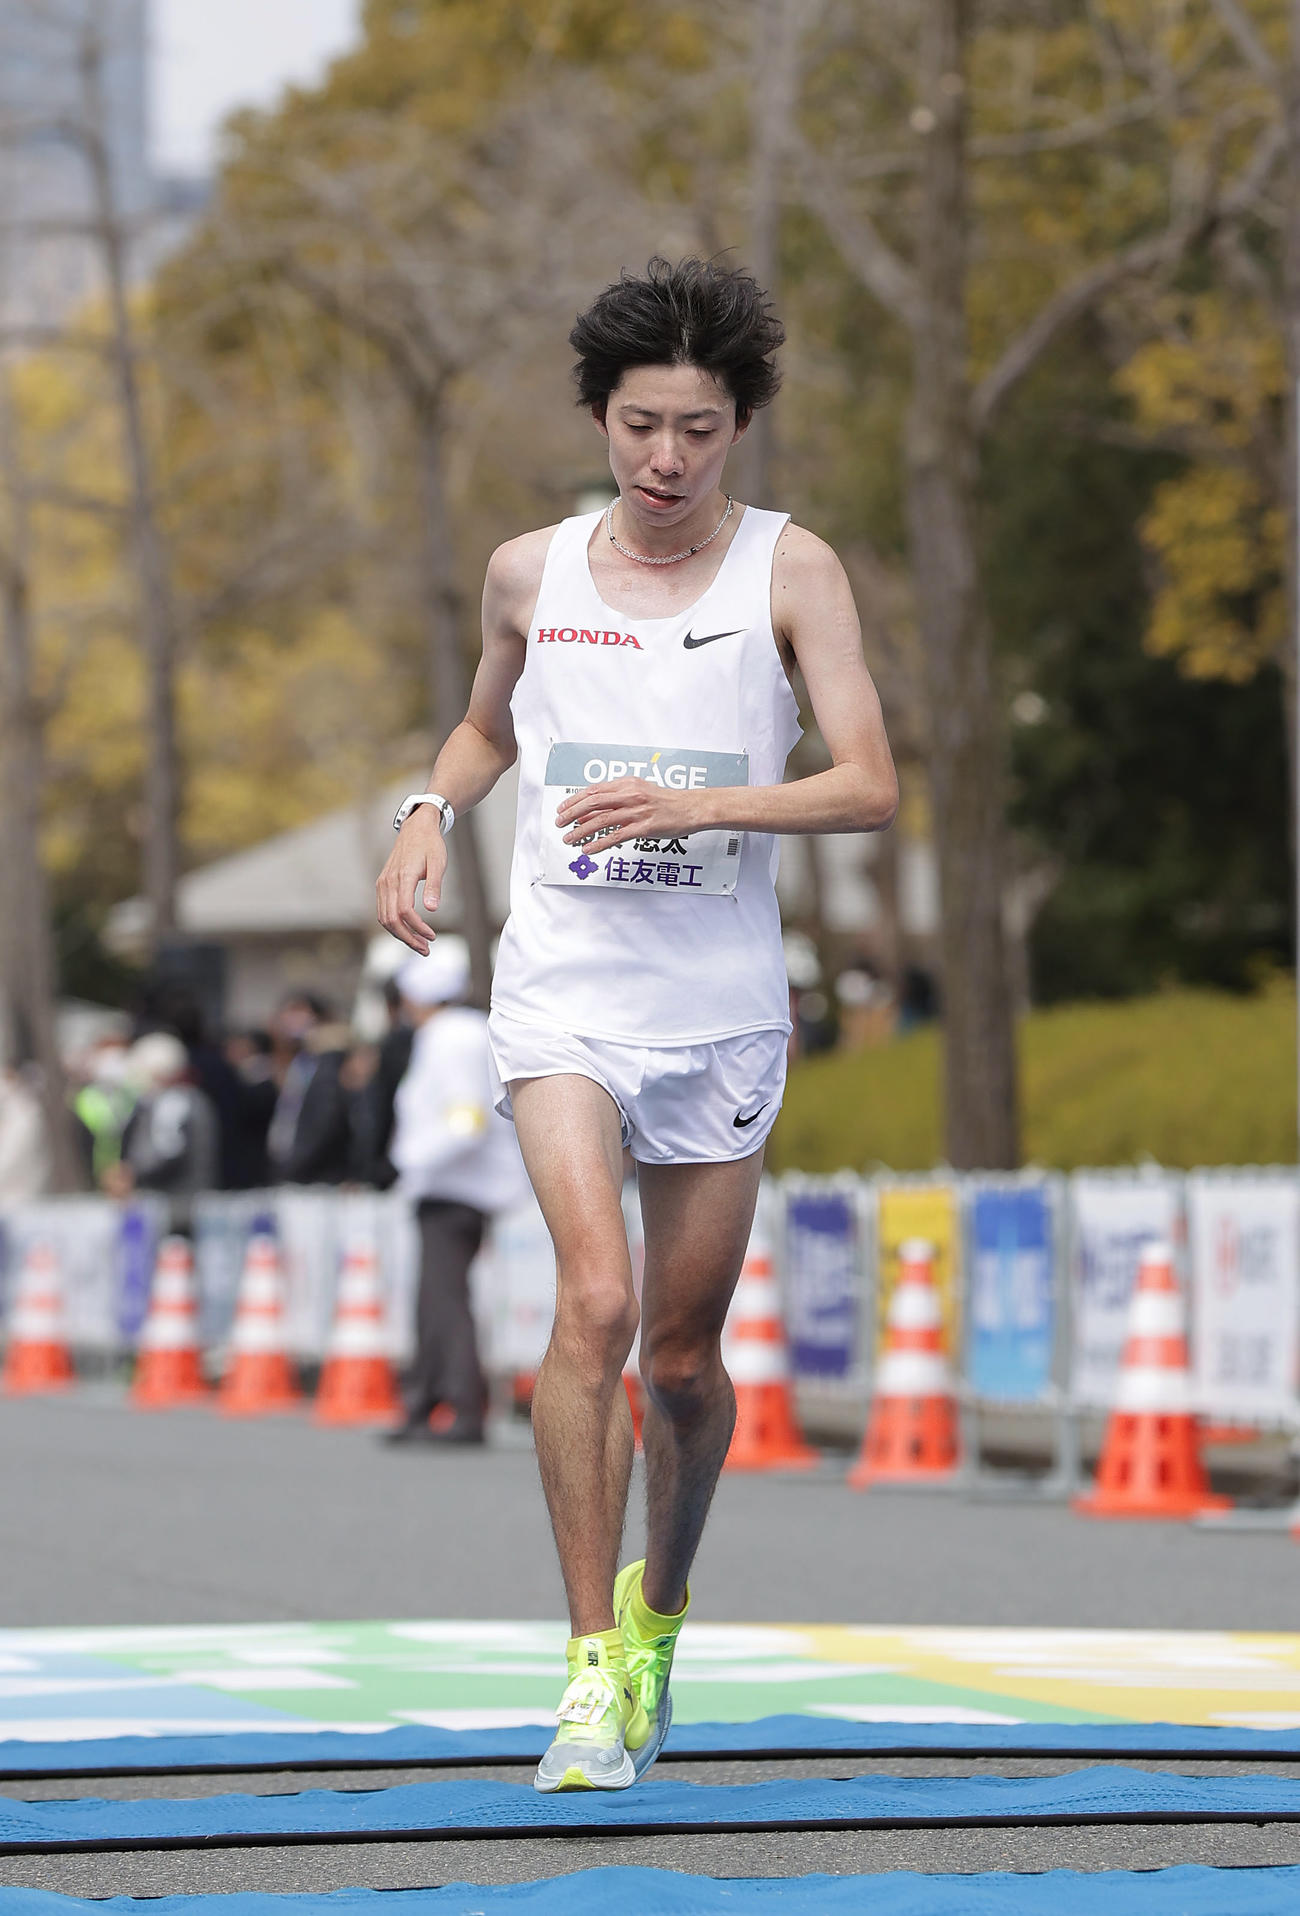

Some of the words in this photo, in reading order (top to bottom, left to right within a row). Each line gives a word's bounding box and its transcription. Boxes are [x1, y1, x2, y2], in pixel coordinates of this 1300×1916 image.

[537, 628, 644, 650] HONDA
[583, 752, 708, 790] OPTAGE
[605, 856, 704, 887] 住友電工
